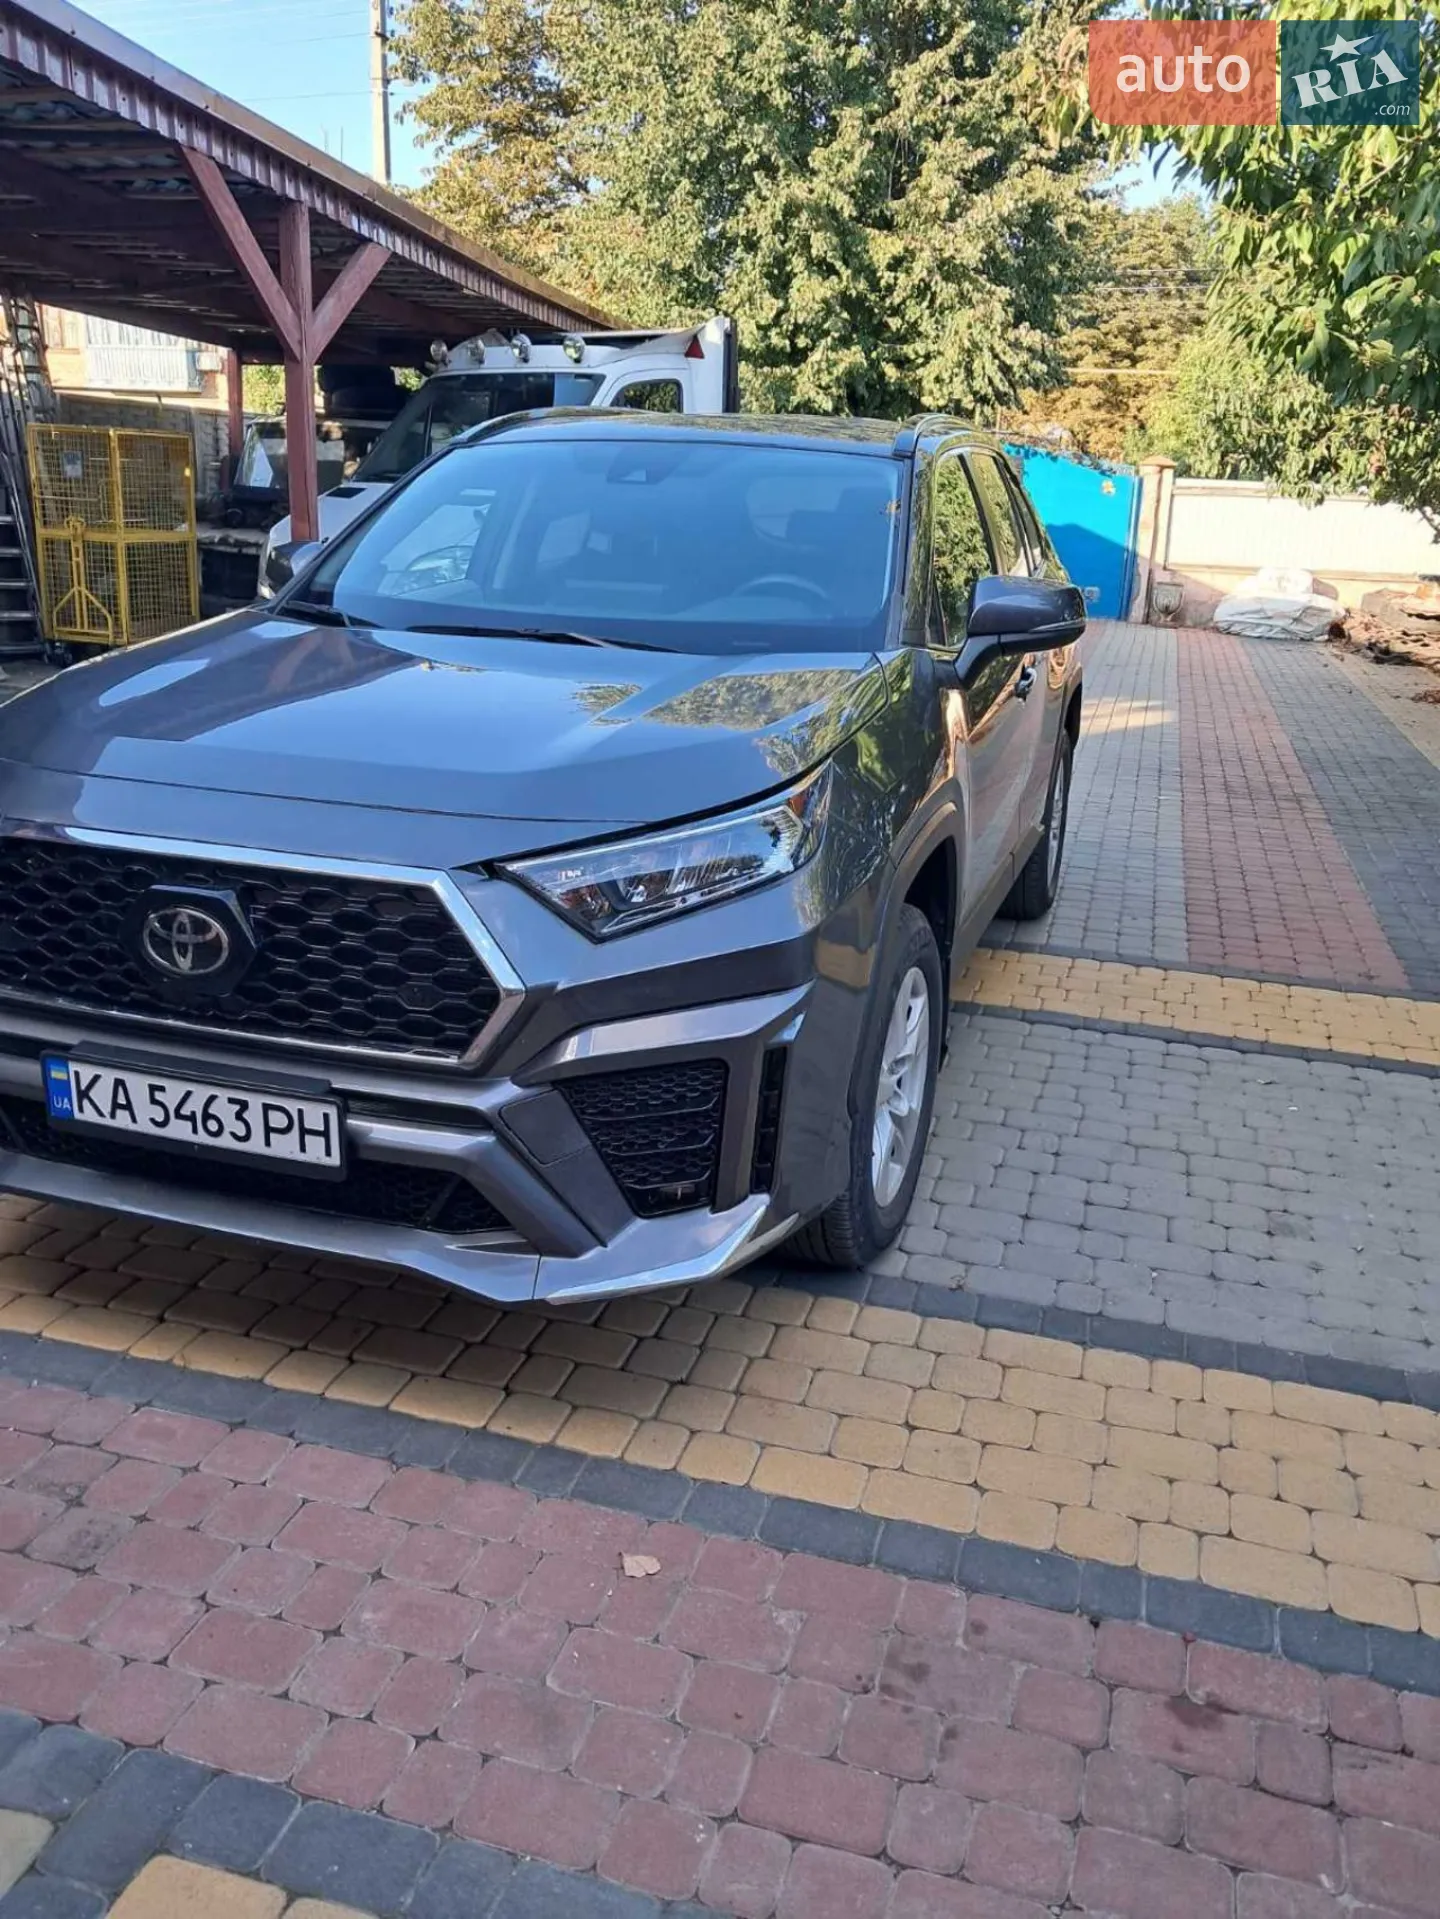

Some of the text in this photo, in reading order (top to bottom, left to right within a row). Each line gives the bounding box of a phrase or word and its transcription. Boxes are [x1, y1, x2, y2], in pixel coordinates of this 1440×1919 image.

[53, 1096, 72, 1110] UA
[73, 1069, 332, 1157] KA 5463 PH
